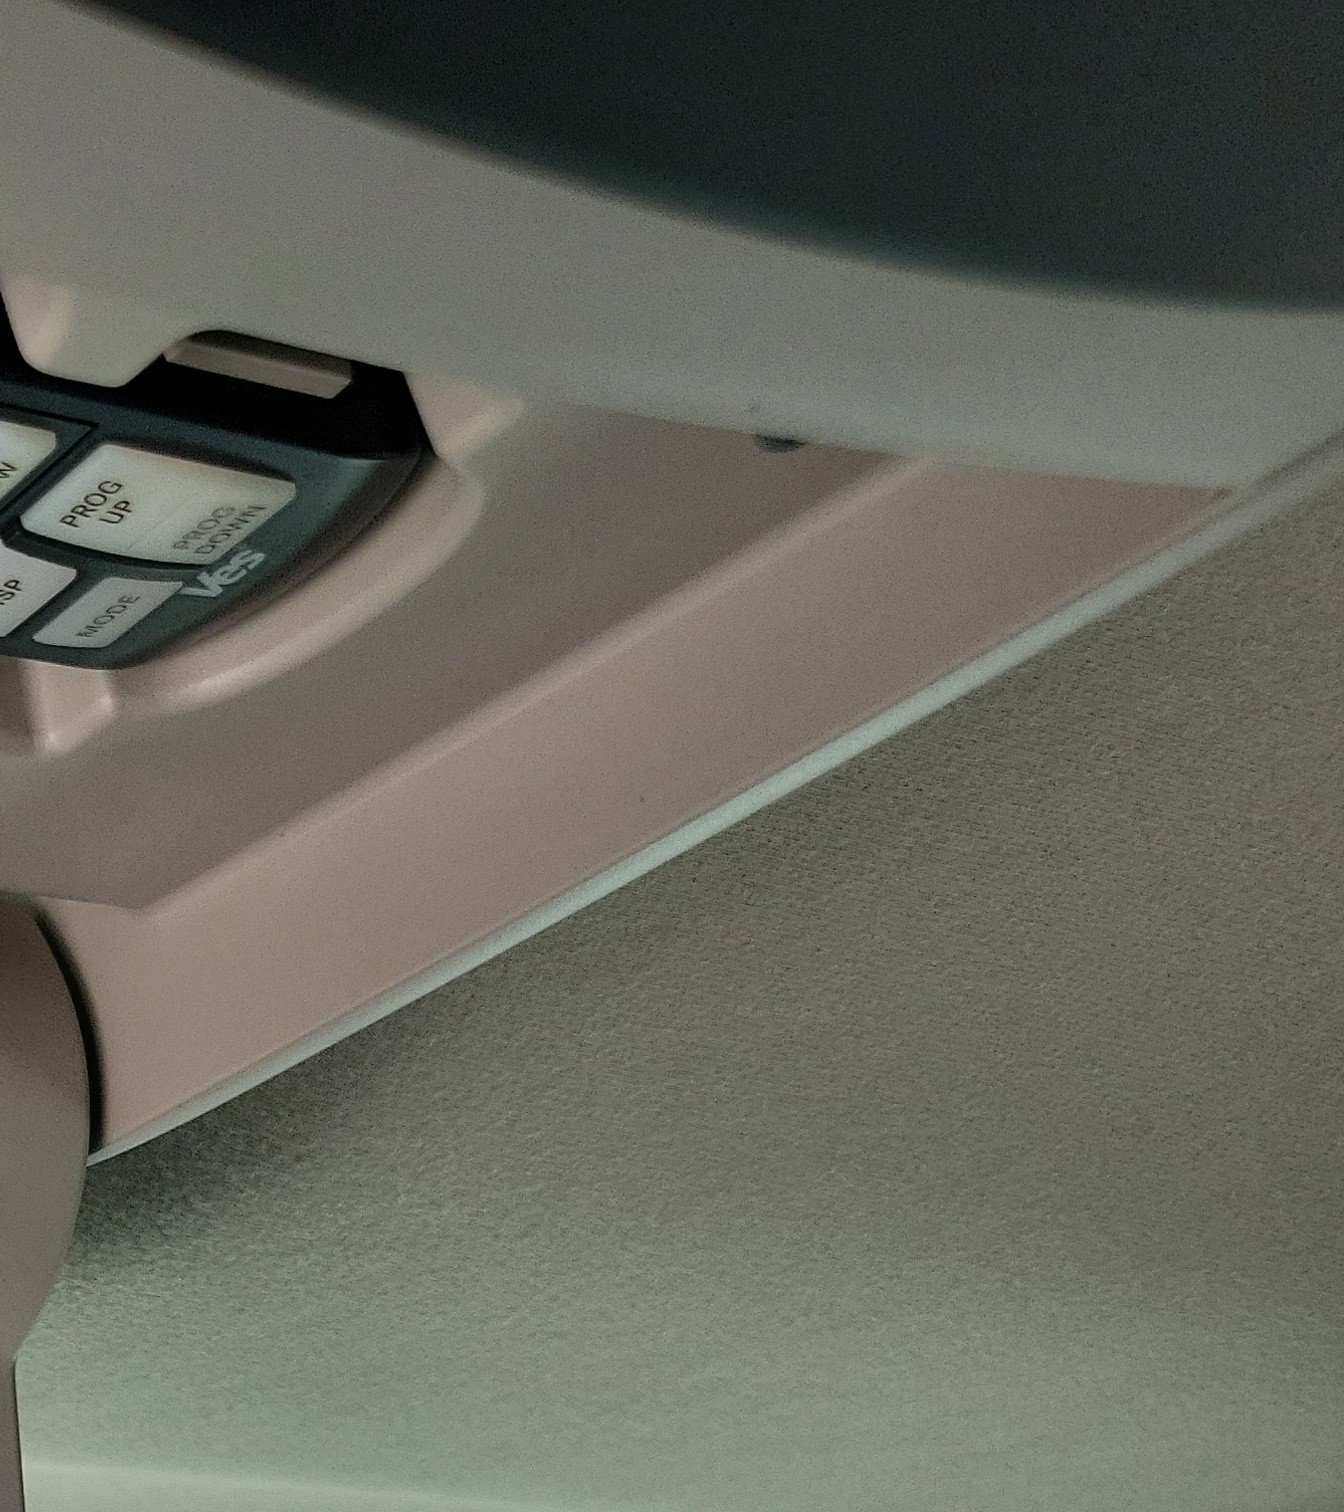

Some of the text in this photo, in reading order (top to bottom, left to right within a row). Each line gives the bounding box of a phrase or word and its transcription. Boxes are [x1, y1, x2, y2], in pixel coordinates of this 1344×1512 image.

[60, 480, 123, 528] PROG
[100, 499, 133, 525] UP
[172, 506, 238, 551] PROG
[194, 506, 268, 555] DOWN
[76, 595, 141, 639] MODE
